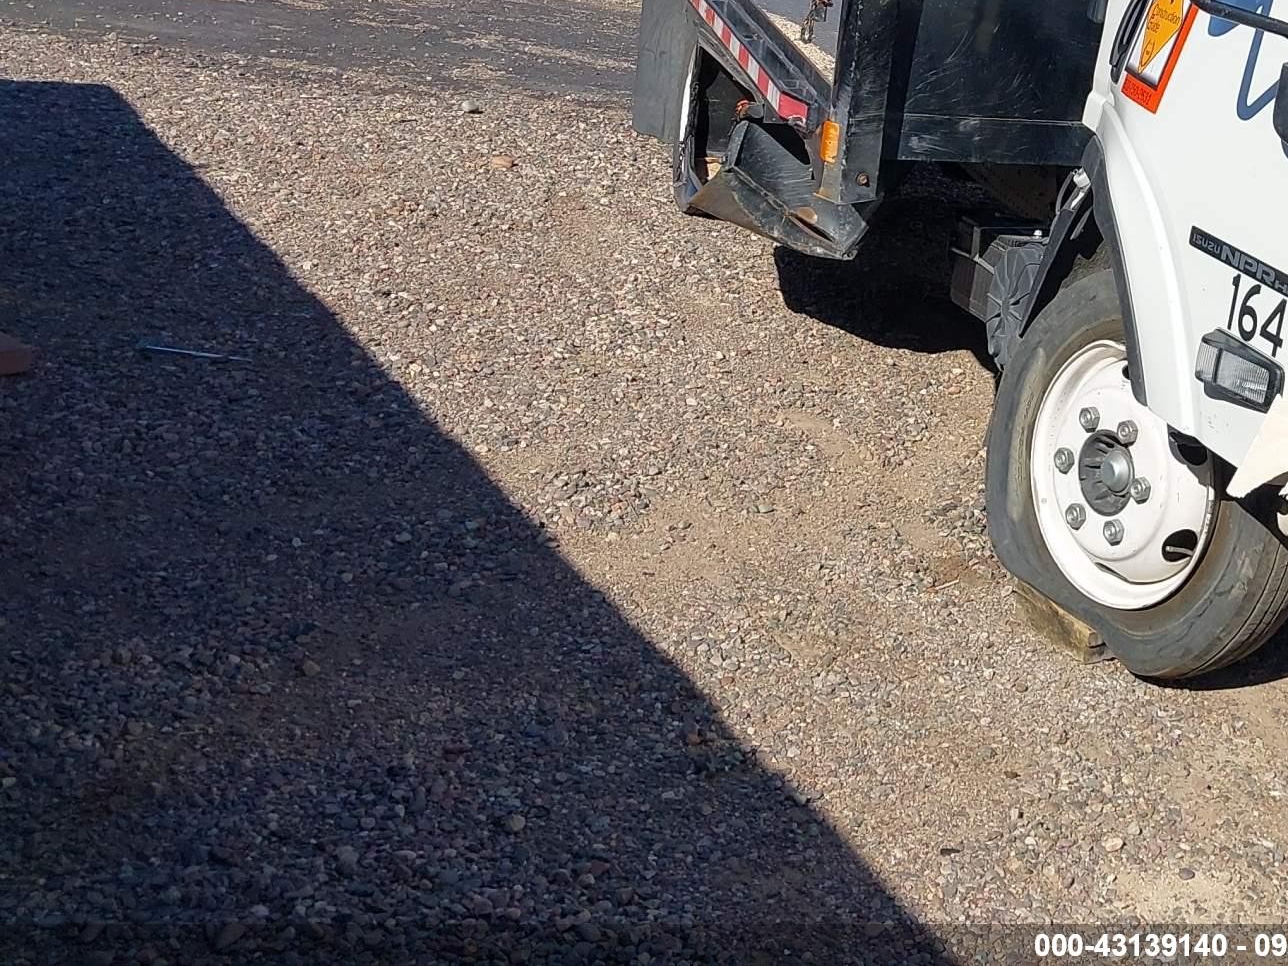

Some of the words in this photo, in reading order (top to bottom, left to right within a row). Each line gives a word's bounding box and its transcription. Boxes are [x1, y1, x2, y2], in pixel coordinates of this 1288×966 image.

[1192, 233, 1222, 255] ISUZU
[1220, 244, 1276, 287] NPR
[1227, 273, 1287, 357] 164
